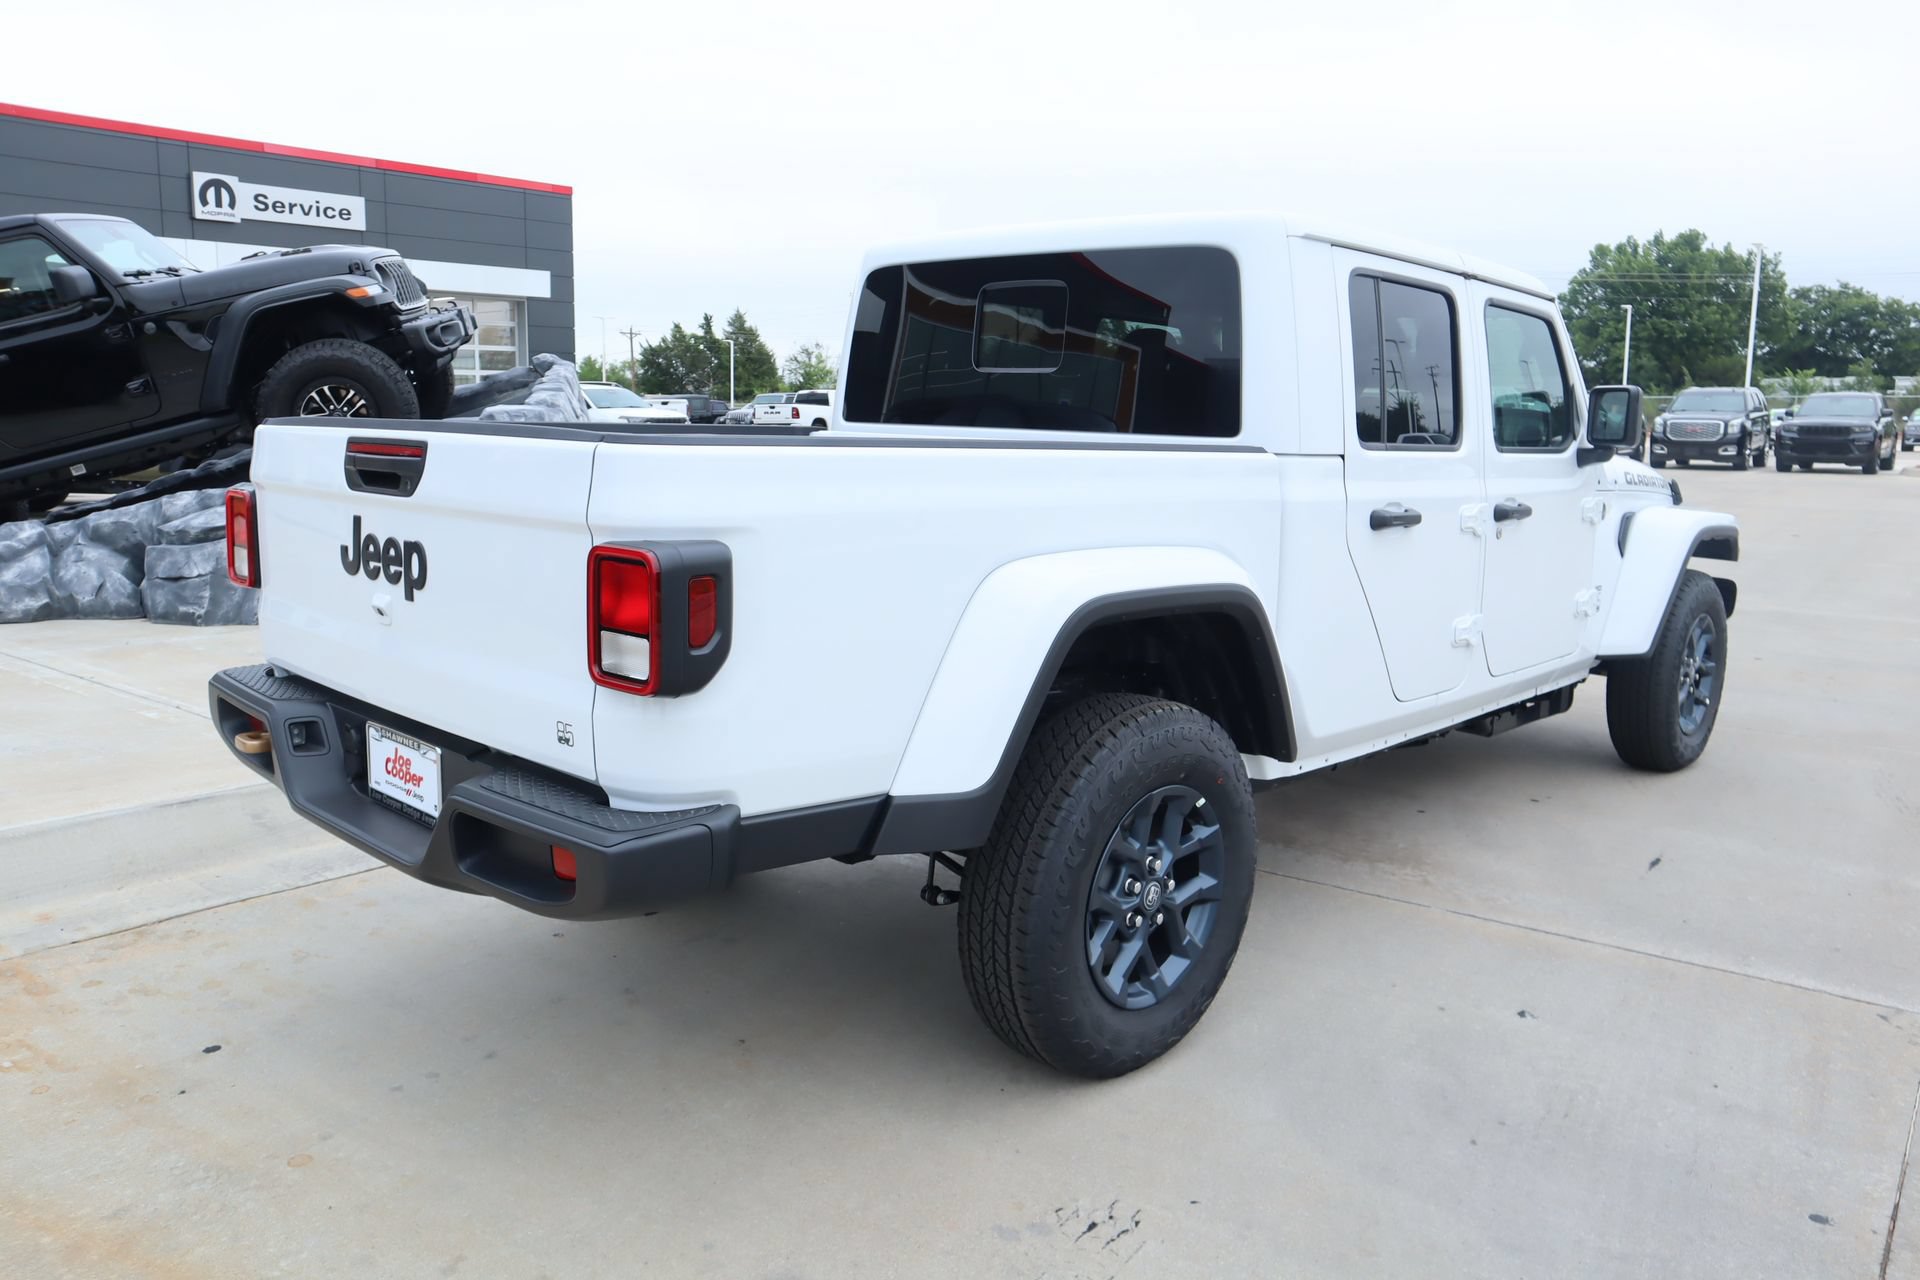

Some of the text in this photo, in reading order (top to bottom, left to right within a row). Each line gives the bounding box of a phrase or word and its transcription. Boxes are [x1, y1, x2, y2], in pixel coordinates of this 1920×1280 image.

[201, 210, 236, 218] MOPAR
[253, 193, 352, 221] Service
[340, 514, 428, 603] Jeep
[381, 728, 419, 750] SHAWNEE
[556, 720, 575, 748] 85
[385, 757, 423, 788] Cooper
[392, 747, 411, 770] Joe
